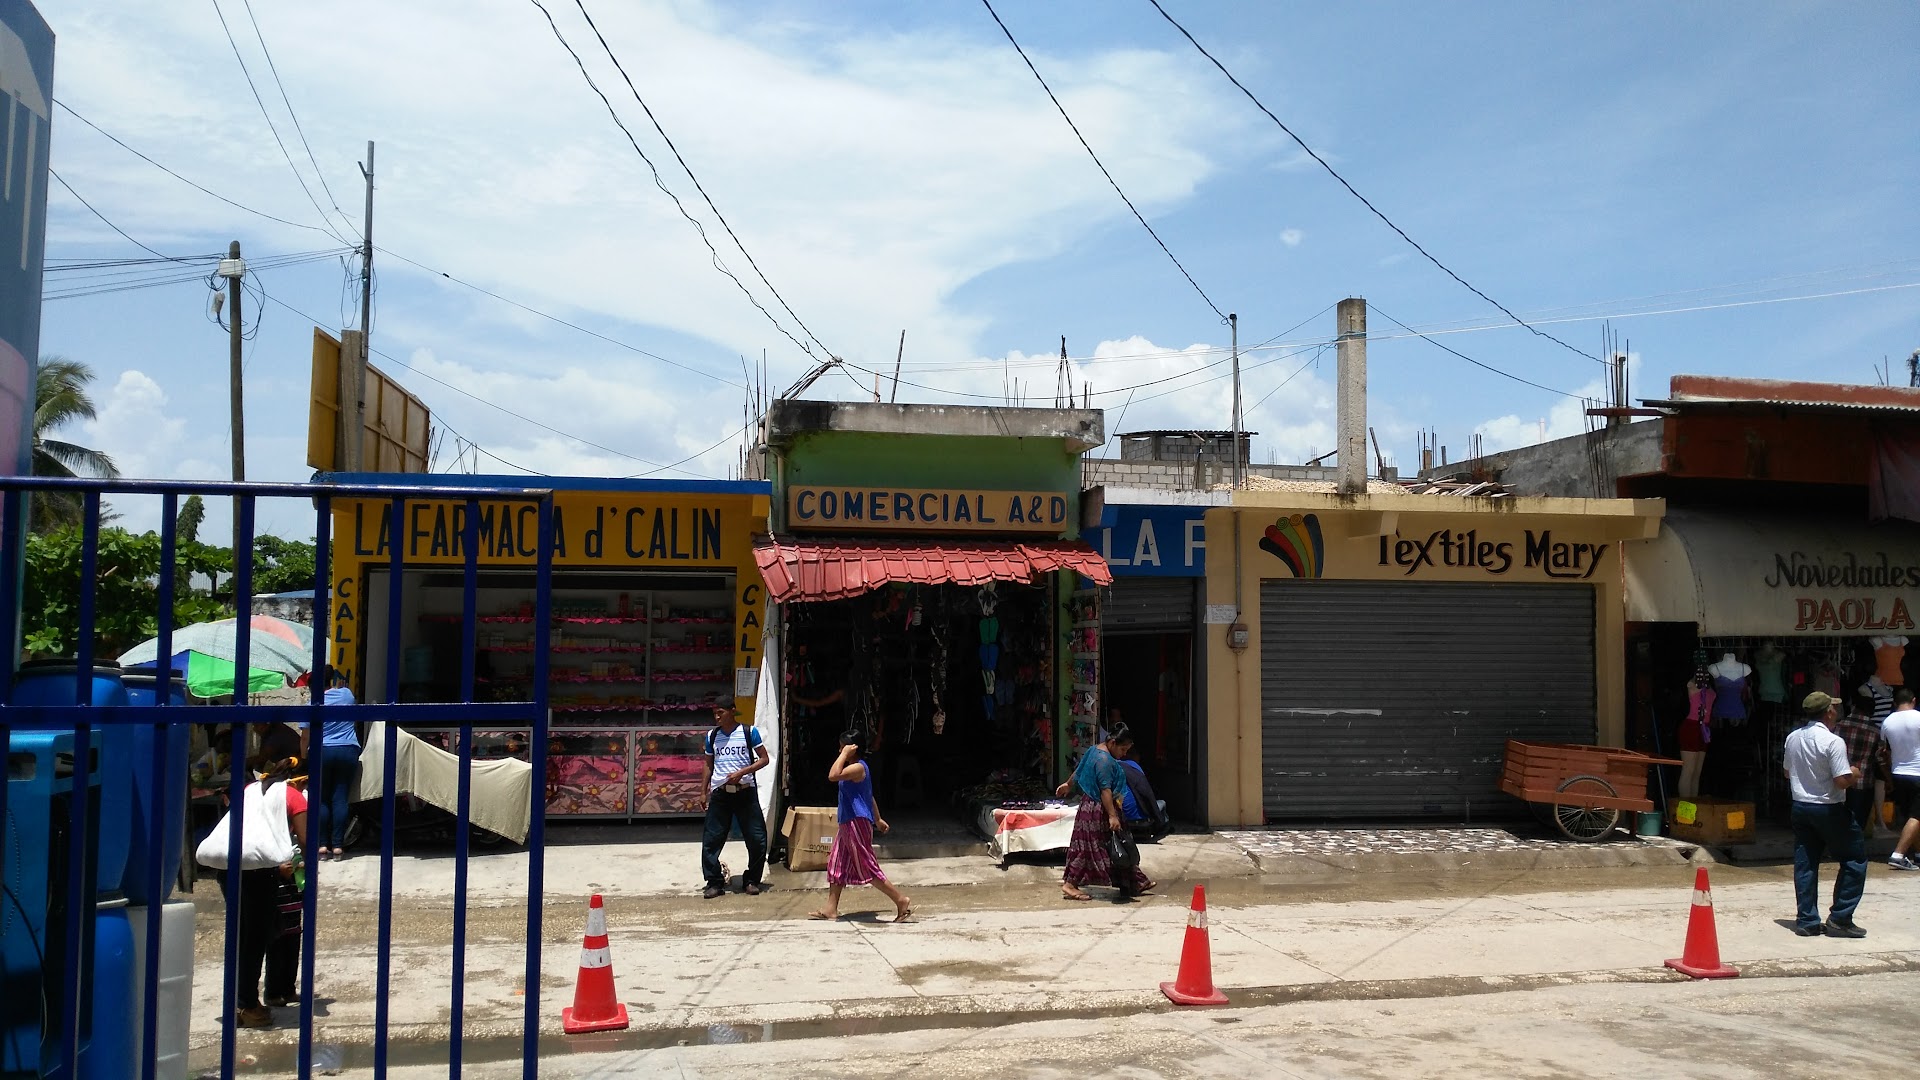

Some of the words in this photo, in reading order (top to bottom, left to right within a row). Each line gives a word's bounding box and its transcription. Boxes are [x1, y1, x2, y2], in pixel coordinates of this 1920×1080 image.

[797, 490, 996, 523] COMERCIAL
[1008, 495, 1066, 524] A&D
[354, 502, 392, 556] LA
[410, 503, 566, 558] FARMACA
[1102, 518, 1161, 566] LA
[1378, 528, 1514, 576] Textiles
[1523, 529, 1609, 579] Mary
[1764, 551, 1920, 588] Novedades
[1794, 597, 1916, 632] PAOLA
[715, 746, 747, 756] ACOSTE
